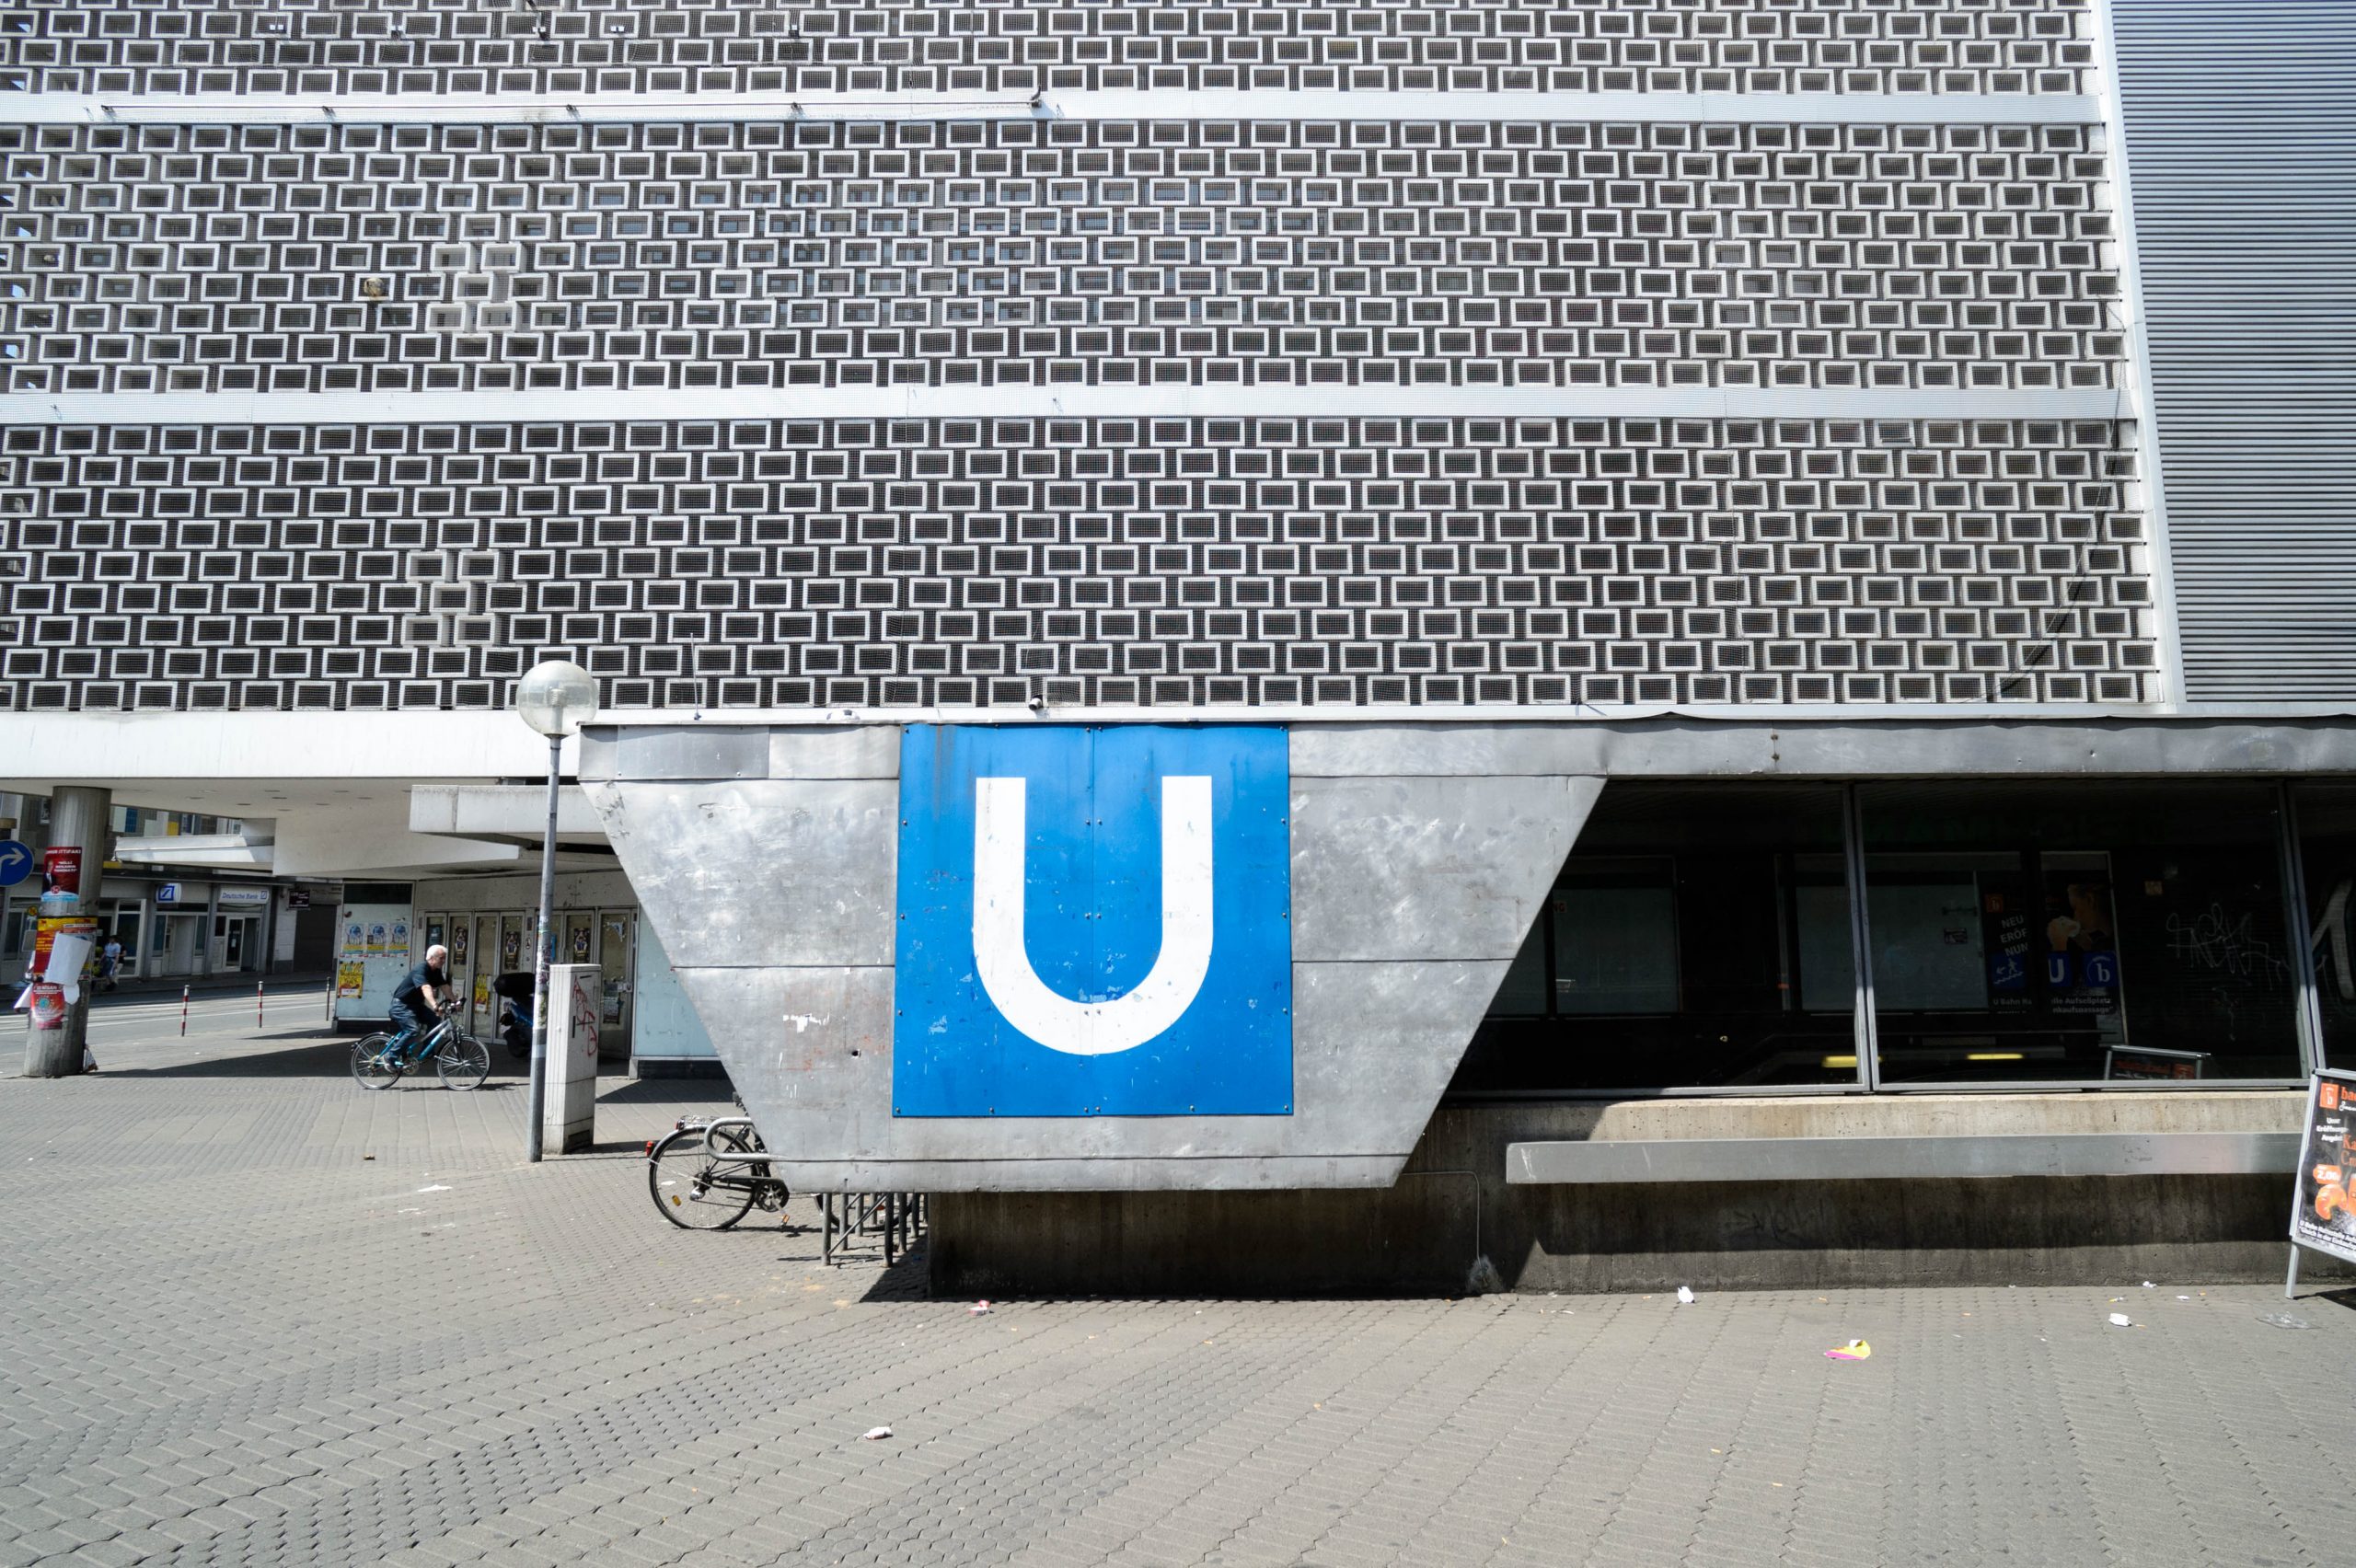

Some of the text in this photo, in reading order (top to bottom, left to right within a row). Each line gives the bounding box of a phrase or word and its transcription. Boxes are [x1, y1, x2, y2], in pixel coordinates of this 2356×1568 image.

[221, 888, 246, 899] Deutsche
[972, 775, 1214, 1056] U
[2001, 915, 2024, 928] NEU
[2000, 928, 2028, 943] ERÖF
[2004, 943, 2029, 956] NUN
[2048, 959, 2065, 983] U
